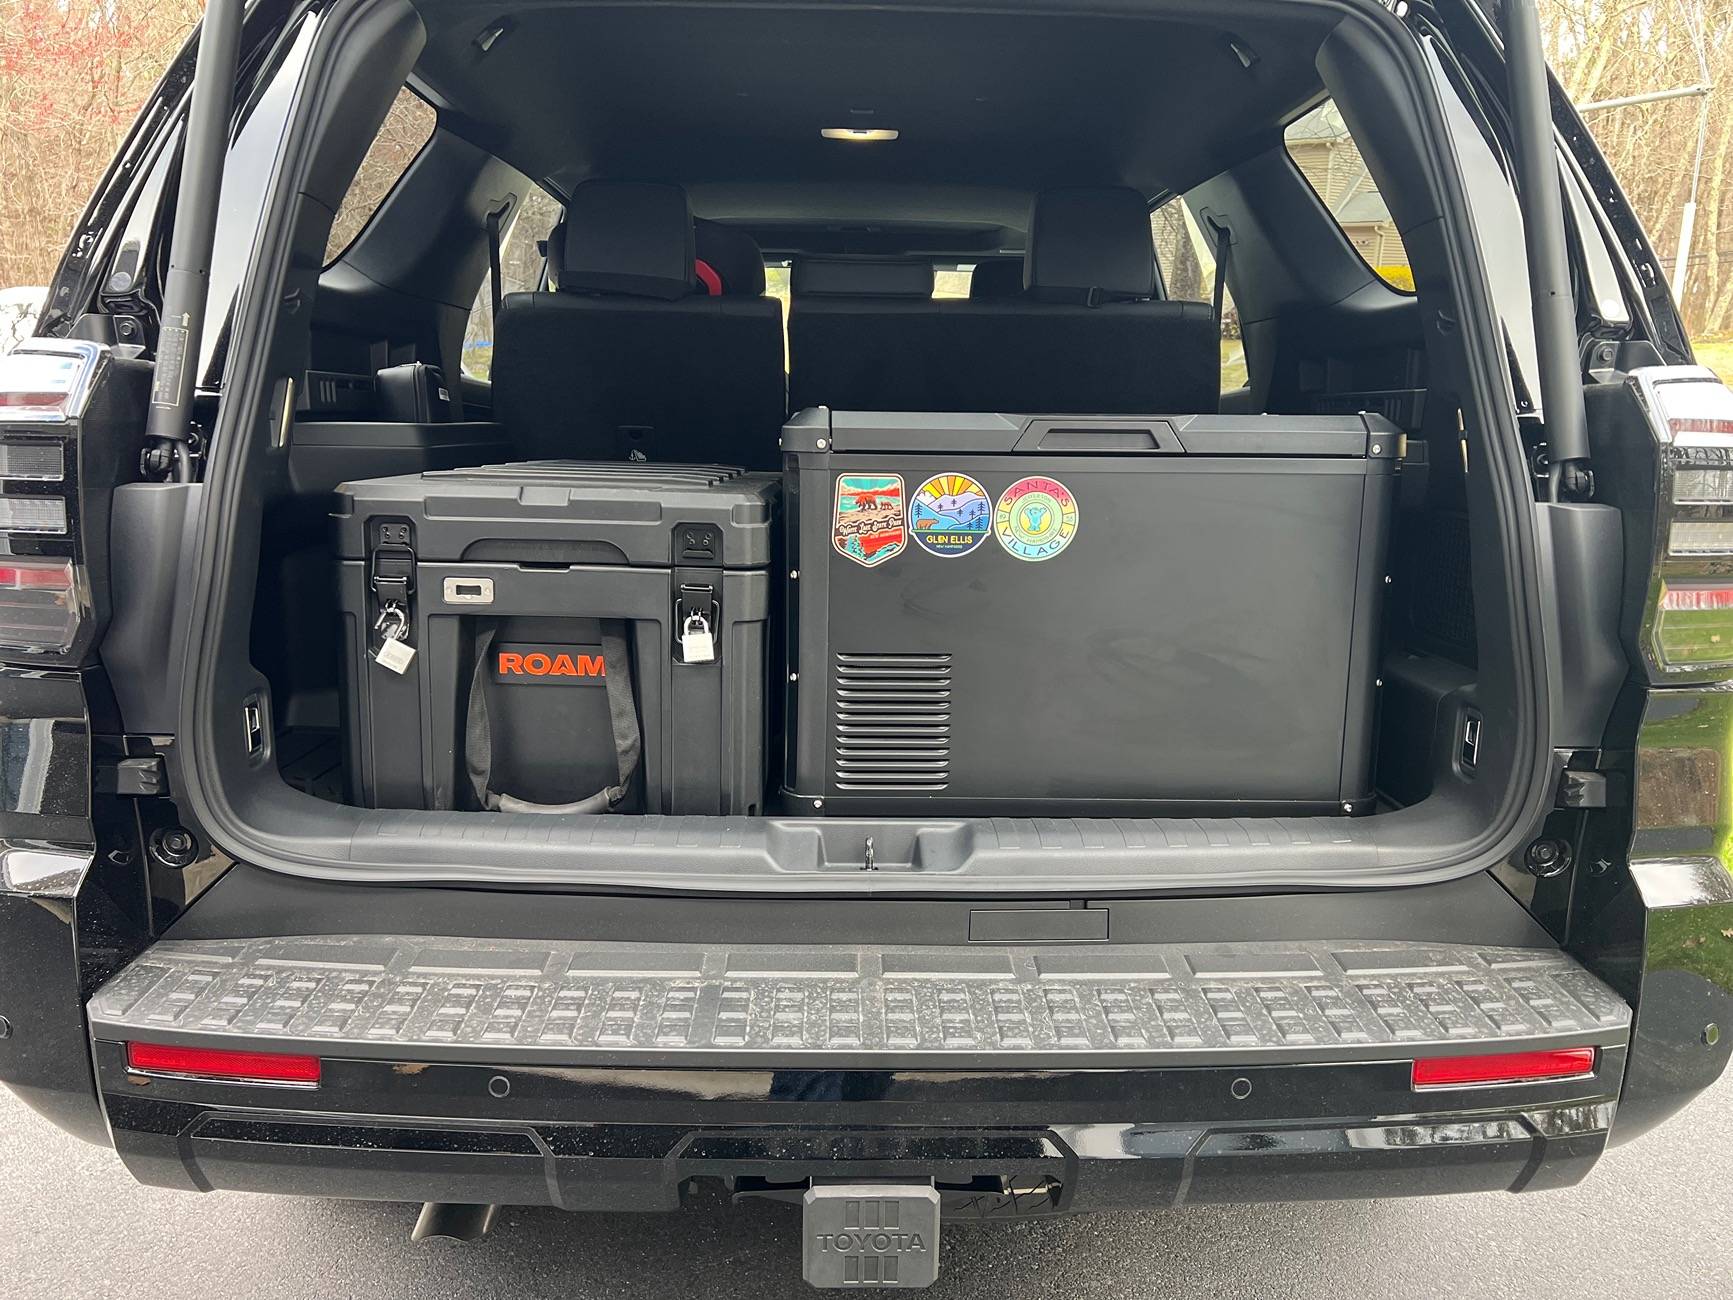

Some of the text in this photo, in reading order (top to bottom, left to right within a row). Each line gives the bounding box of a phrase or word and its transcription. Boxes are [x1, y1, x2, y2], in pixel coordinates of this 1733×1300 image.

[1004, 481, 1070, 507] SANTA'S
[926, 535, 973, 544] GLEN ELLIS
[1002, 526, 1069, 556] VILLAGE
[499, 653, 605, 677] ROAM
[816, 1232, 927, 1253] TOYOTA
